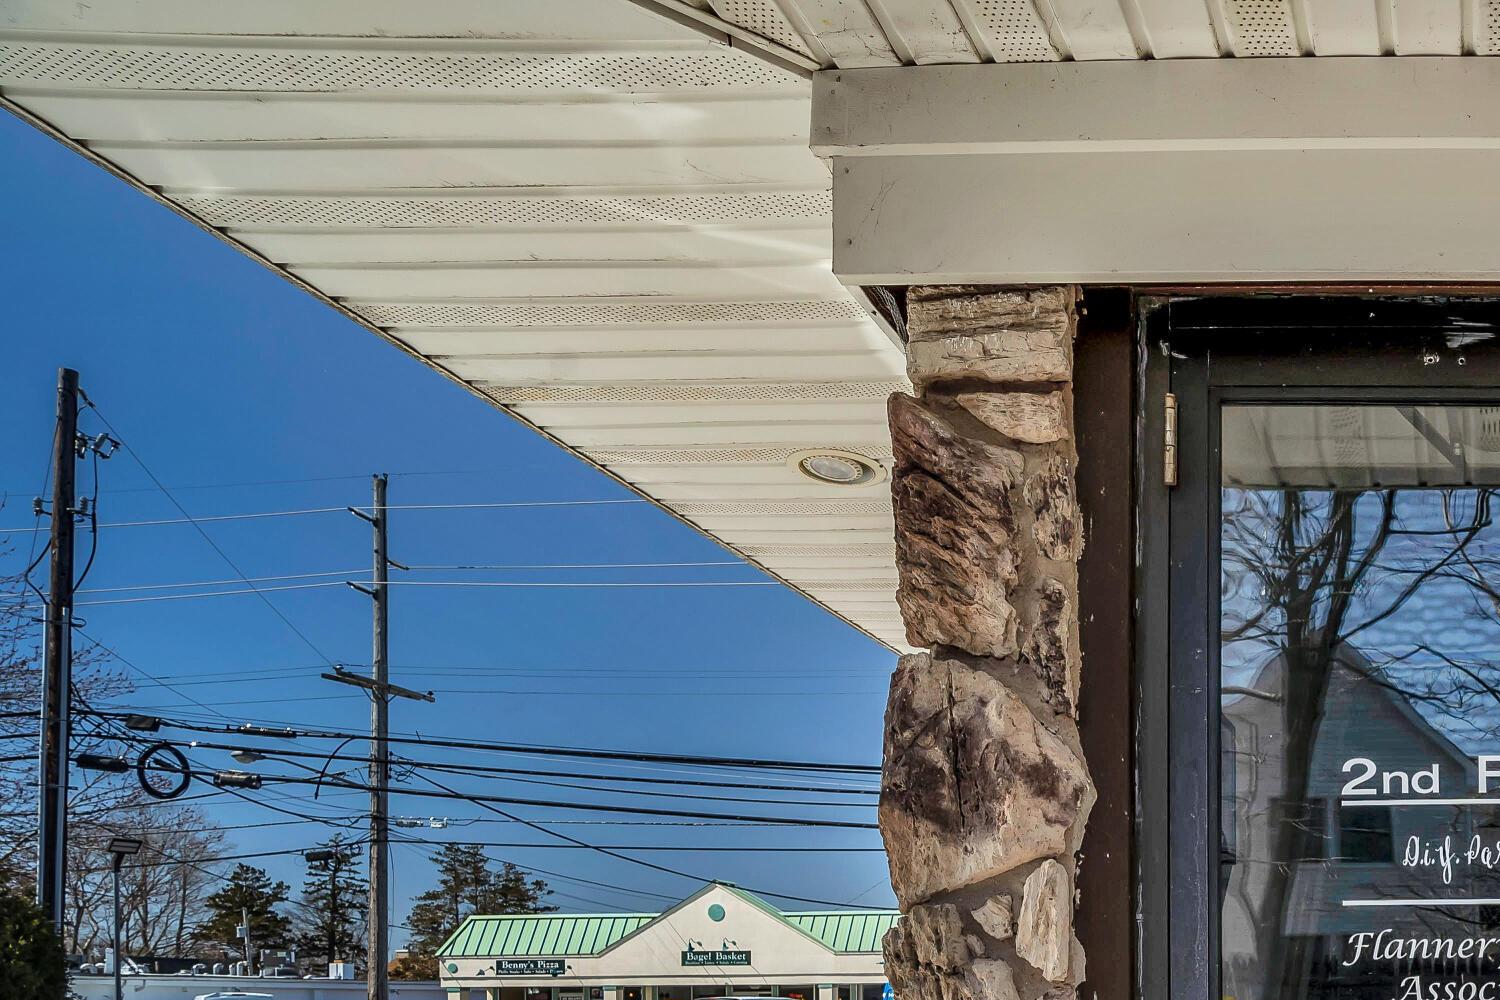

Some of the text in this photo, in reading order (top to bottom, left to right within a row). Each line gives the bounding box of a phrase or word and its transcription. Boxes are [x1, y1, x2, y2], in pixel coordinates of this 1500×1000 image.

[1341, 757, 1440, 795] 2nd
[686, 952, 746, 961] Bagel Basket
[502, 960, 560, 969] Benny's Pizza
